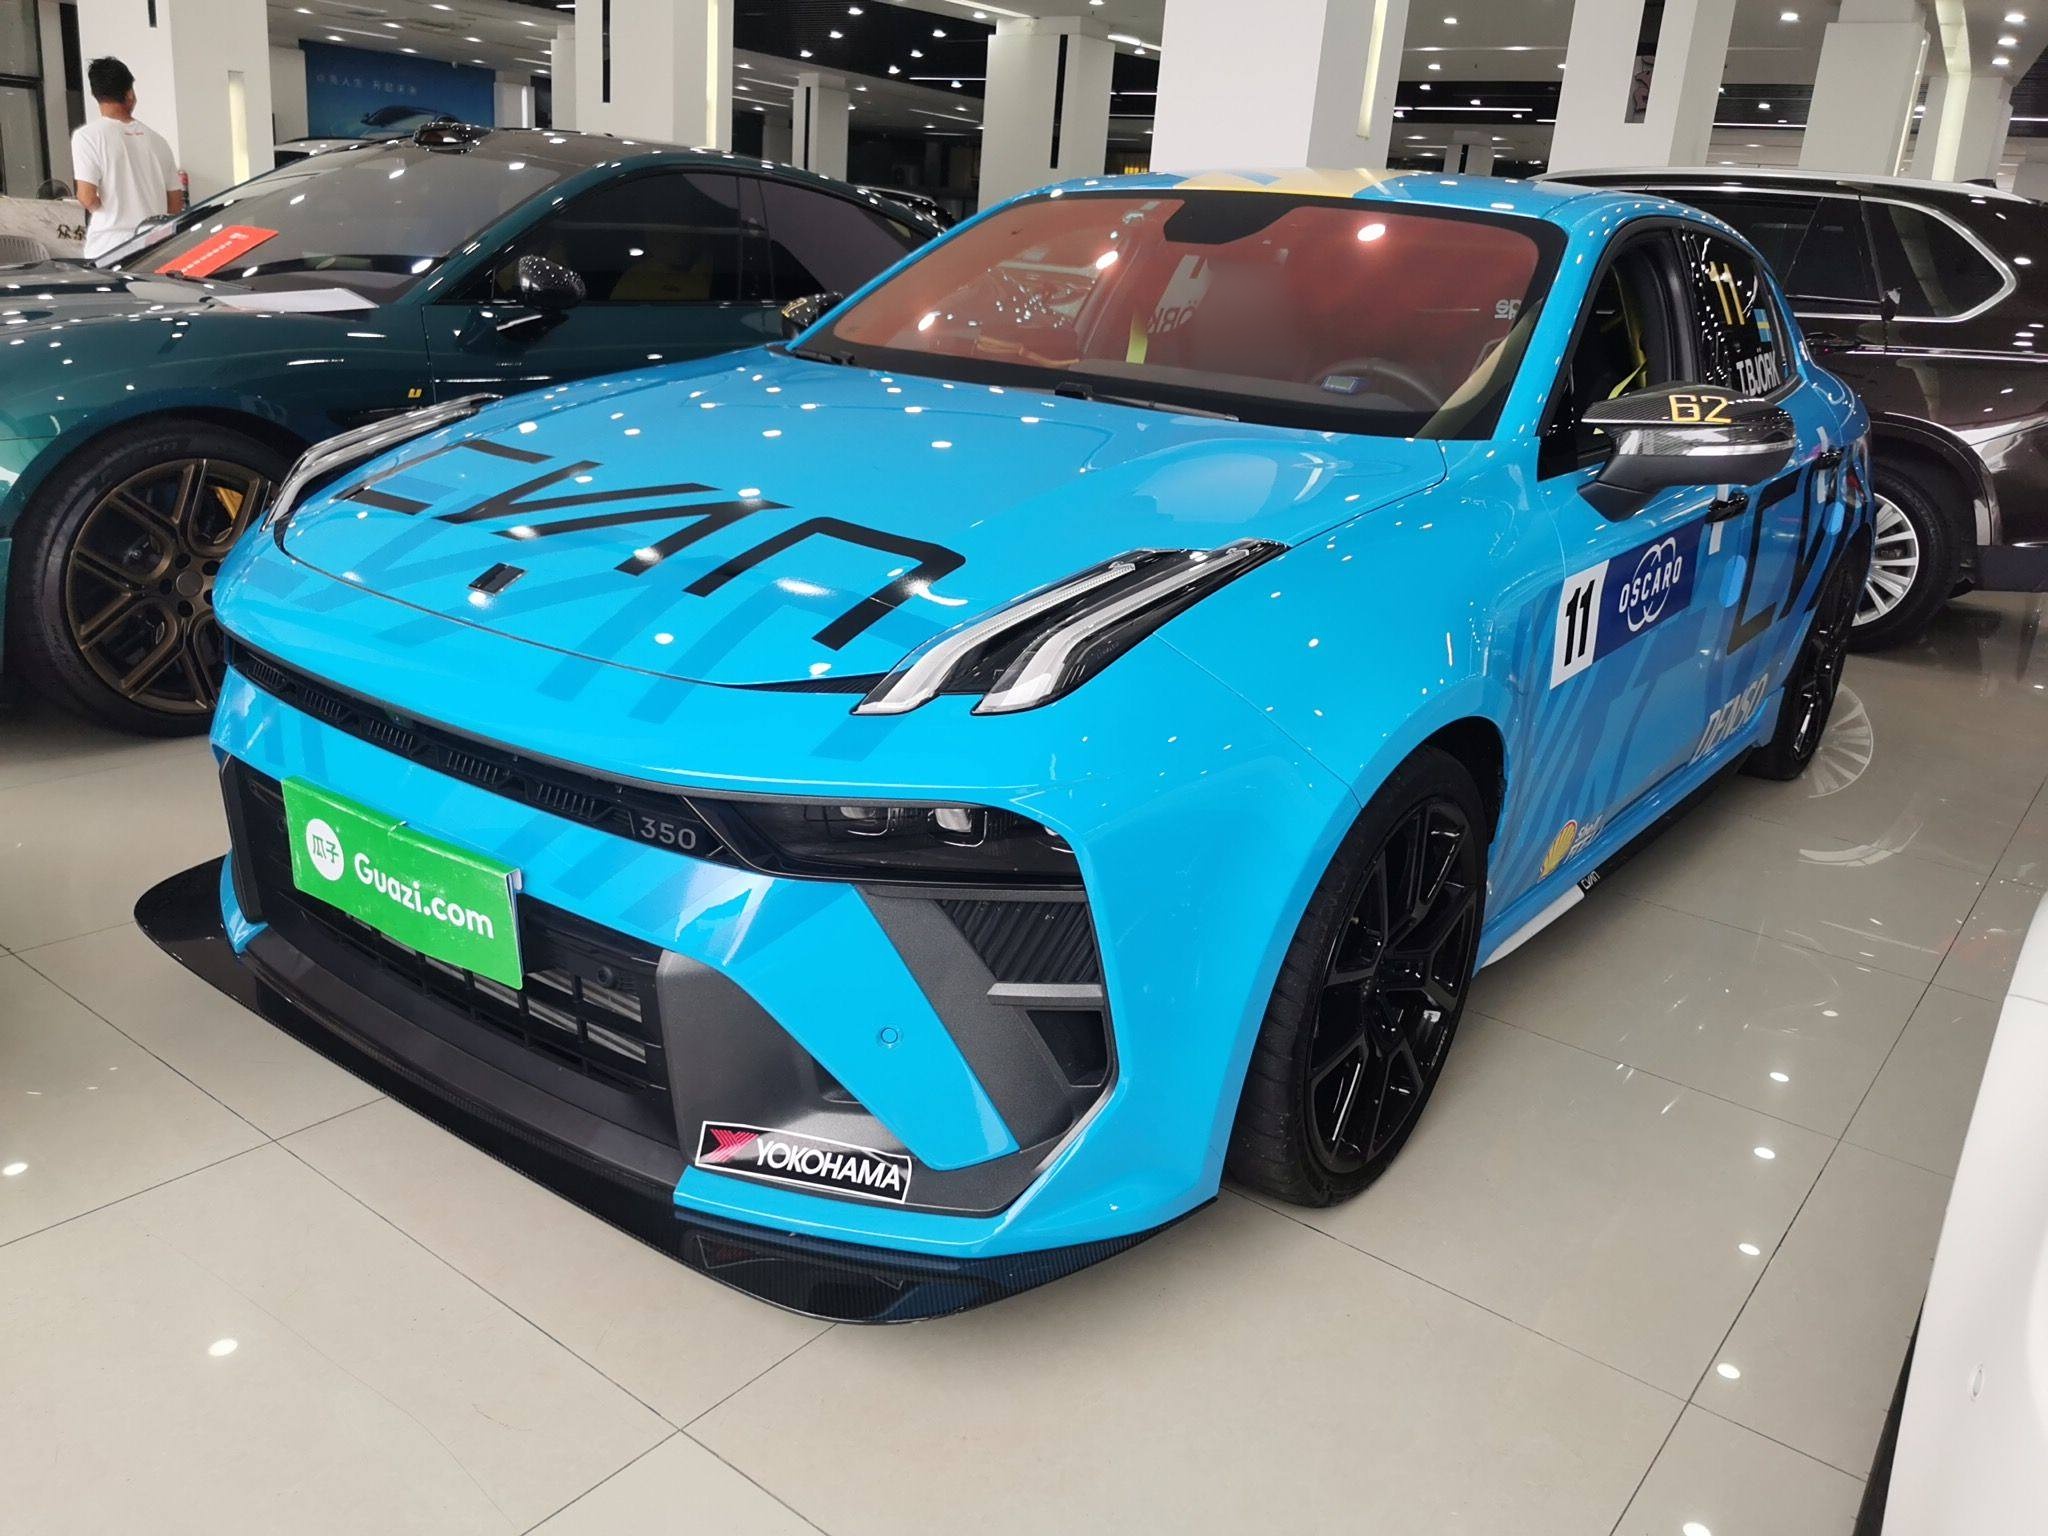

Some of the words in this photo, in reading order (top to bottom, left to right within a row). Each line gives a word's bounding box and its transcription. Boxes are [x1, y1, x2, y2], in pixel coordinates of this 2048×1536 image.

[1707, 261, 1745, 326] 11
[1669, 394, 1733, 424] 62
[1618, 555, 1683, 614] OSCARO
[1563, 578, 1596, 667] 11
[312, 835, 340, 864] 瓜子
[640, 816, 697, 850] 350
[354, 852, 495, 939] Guazi.com
[756, 1138, 901, 1192] YOKOHAMA
